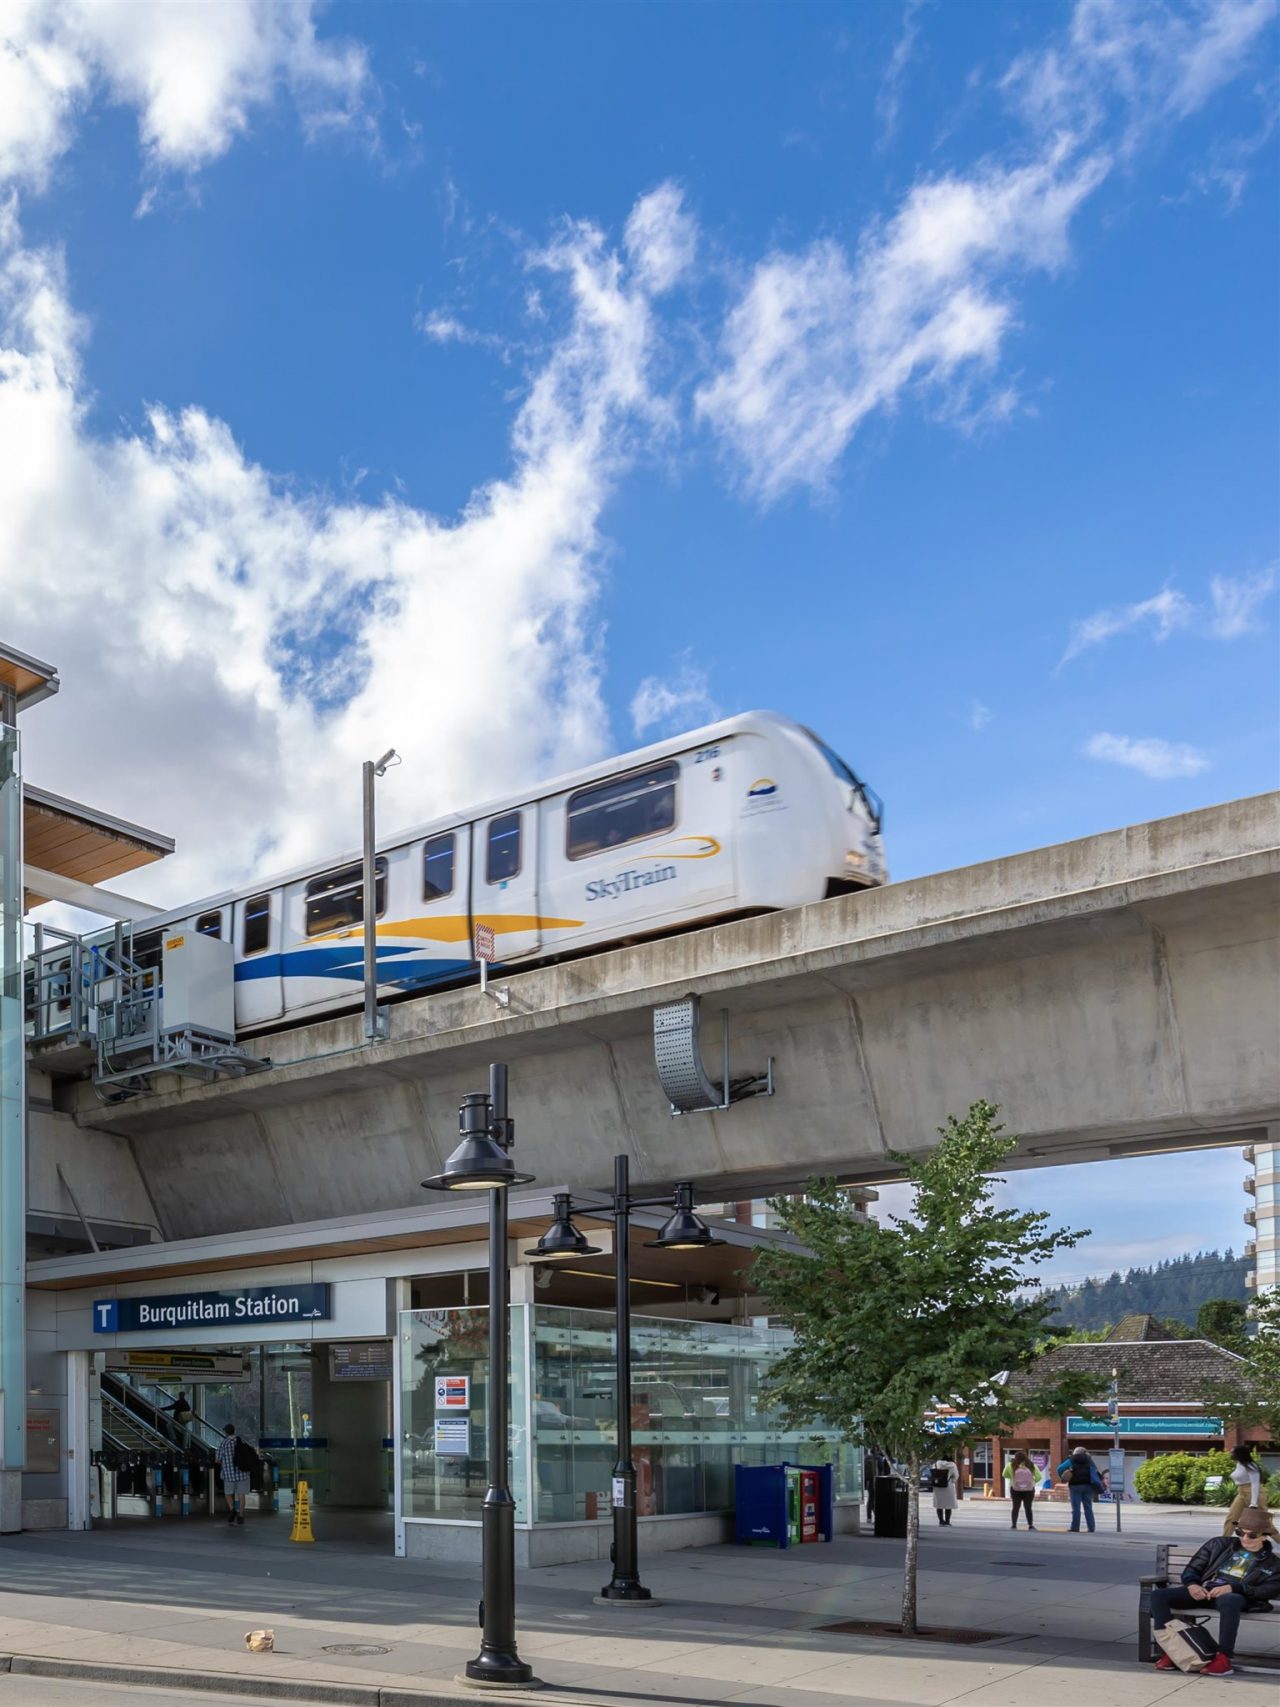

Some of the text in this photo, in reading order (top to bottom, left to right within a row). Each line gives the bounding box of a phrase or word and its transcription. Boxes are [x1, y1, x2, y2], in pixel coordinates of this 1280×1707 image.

[584, 863, 678, 901] SkyTrain
[97, 1294, 299, 1328] T Burquitlam Station
